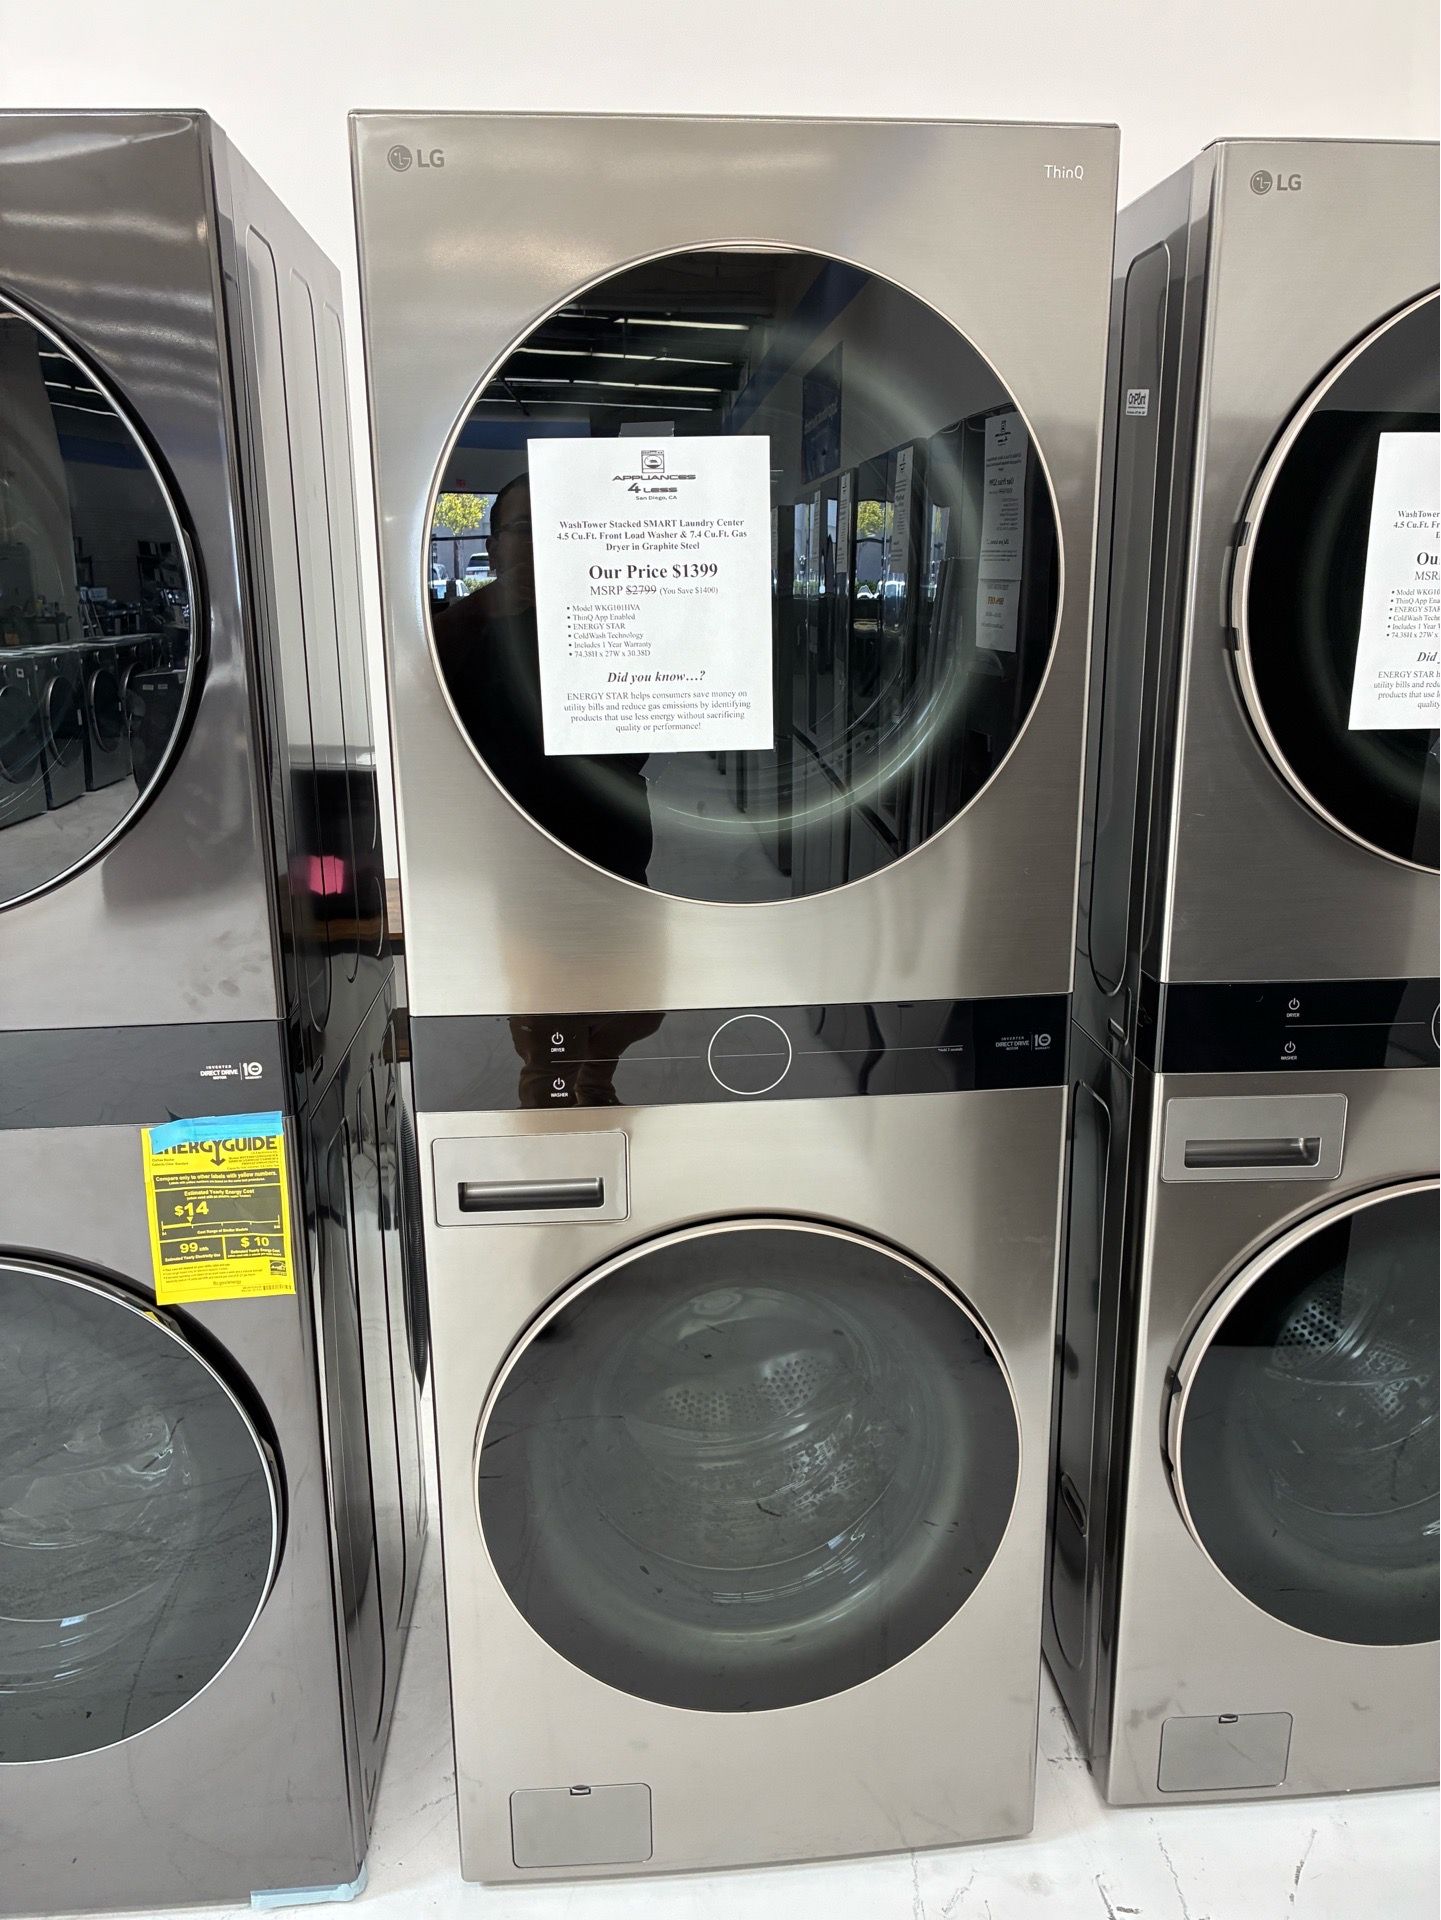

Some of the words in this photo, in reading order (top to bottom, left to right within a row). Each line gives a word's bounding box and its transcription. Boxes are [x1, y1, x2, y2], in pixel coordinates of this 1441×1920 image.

[417, 149, 444, 168] LG
[1044, 164, 1083, 180] ThinQ
[1277, 174, 1301, 190] LG
[627, 483, 641, 493] 4
[609, 520, 641, 528] Stacked
[680, 520, 714, 528] Laundry
[571, 532, 597, 540] Cu.Ft.
[625, 531, 645, 539] Load
[690, 530, 702, 538] 7.4
[704, 530, 729, 538] Cu.Ft.
[606, 543, 630, 552] Dryer
[642, 542, 678, 551] Graphite
[1417, 552, 1439, 565] Ou
[589, 566, 622, 579] Our
[627, 565, 667, 578] Price
[672, 564, 718, 578] $1399
[1415, 571, 1440, 580] MSR
[590, 586, 623, 595] MSRP
[625, 585, 657, 595] $2799
[572, 614, 593, 622] ThinQ
[594, 614, 608, 622] App
[1417, 652, 1437, 661] Did
[607, 672, 628, 682] Did
[630, 675, 651, 685] you
[655, 671, 705, 681] know...?
[1374, 681, 1394, 689] utility
[567, 692, 604, 700] ENERGY
[606, 692, 628, 700] STAR
[631, 692, 650, 700] helps
[1378, 691, 1407, 699] products
[564, 704, 586, 712] utility
[588, 703, 604, 711] bills
[700, 701, 709, 710] by
[712, 701, 751, 709] identifying
[1417, 701, 1440, 709] quality
[571, 714, 602, 723] products
[707, 711, 745, 720] sacrificing
[616, 724, 641, 733] quality
[653, 723, 701, 732] performance!
[1034, 1034, 1051, 1047] 10
[243, 1062, 262, 1076] 10
[155, 1135, 278, 1155] ERGYGUIDE
[175, 1201, 209, 1217] $14
[241, 1237, 250, 1248] $
[254, 1237, 269, 1247] 10
[180, 1243, 198, 1253] 99
